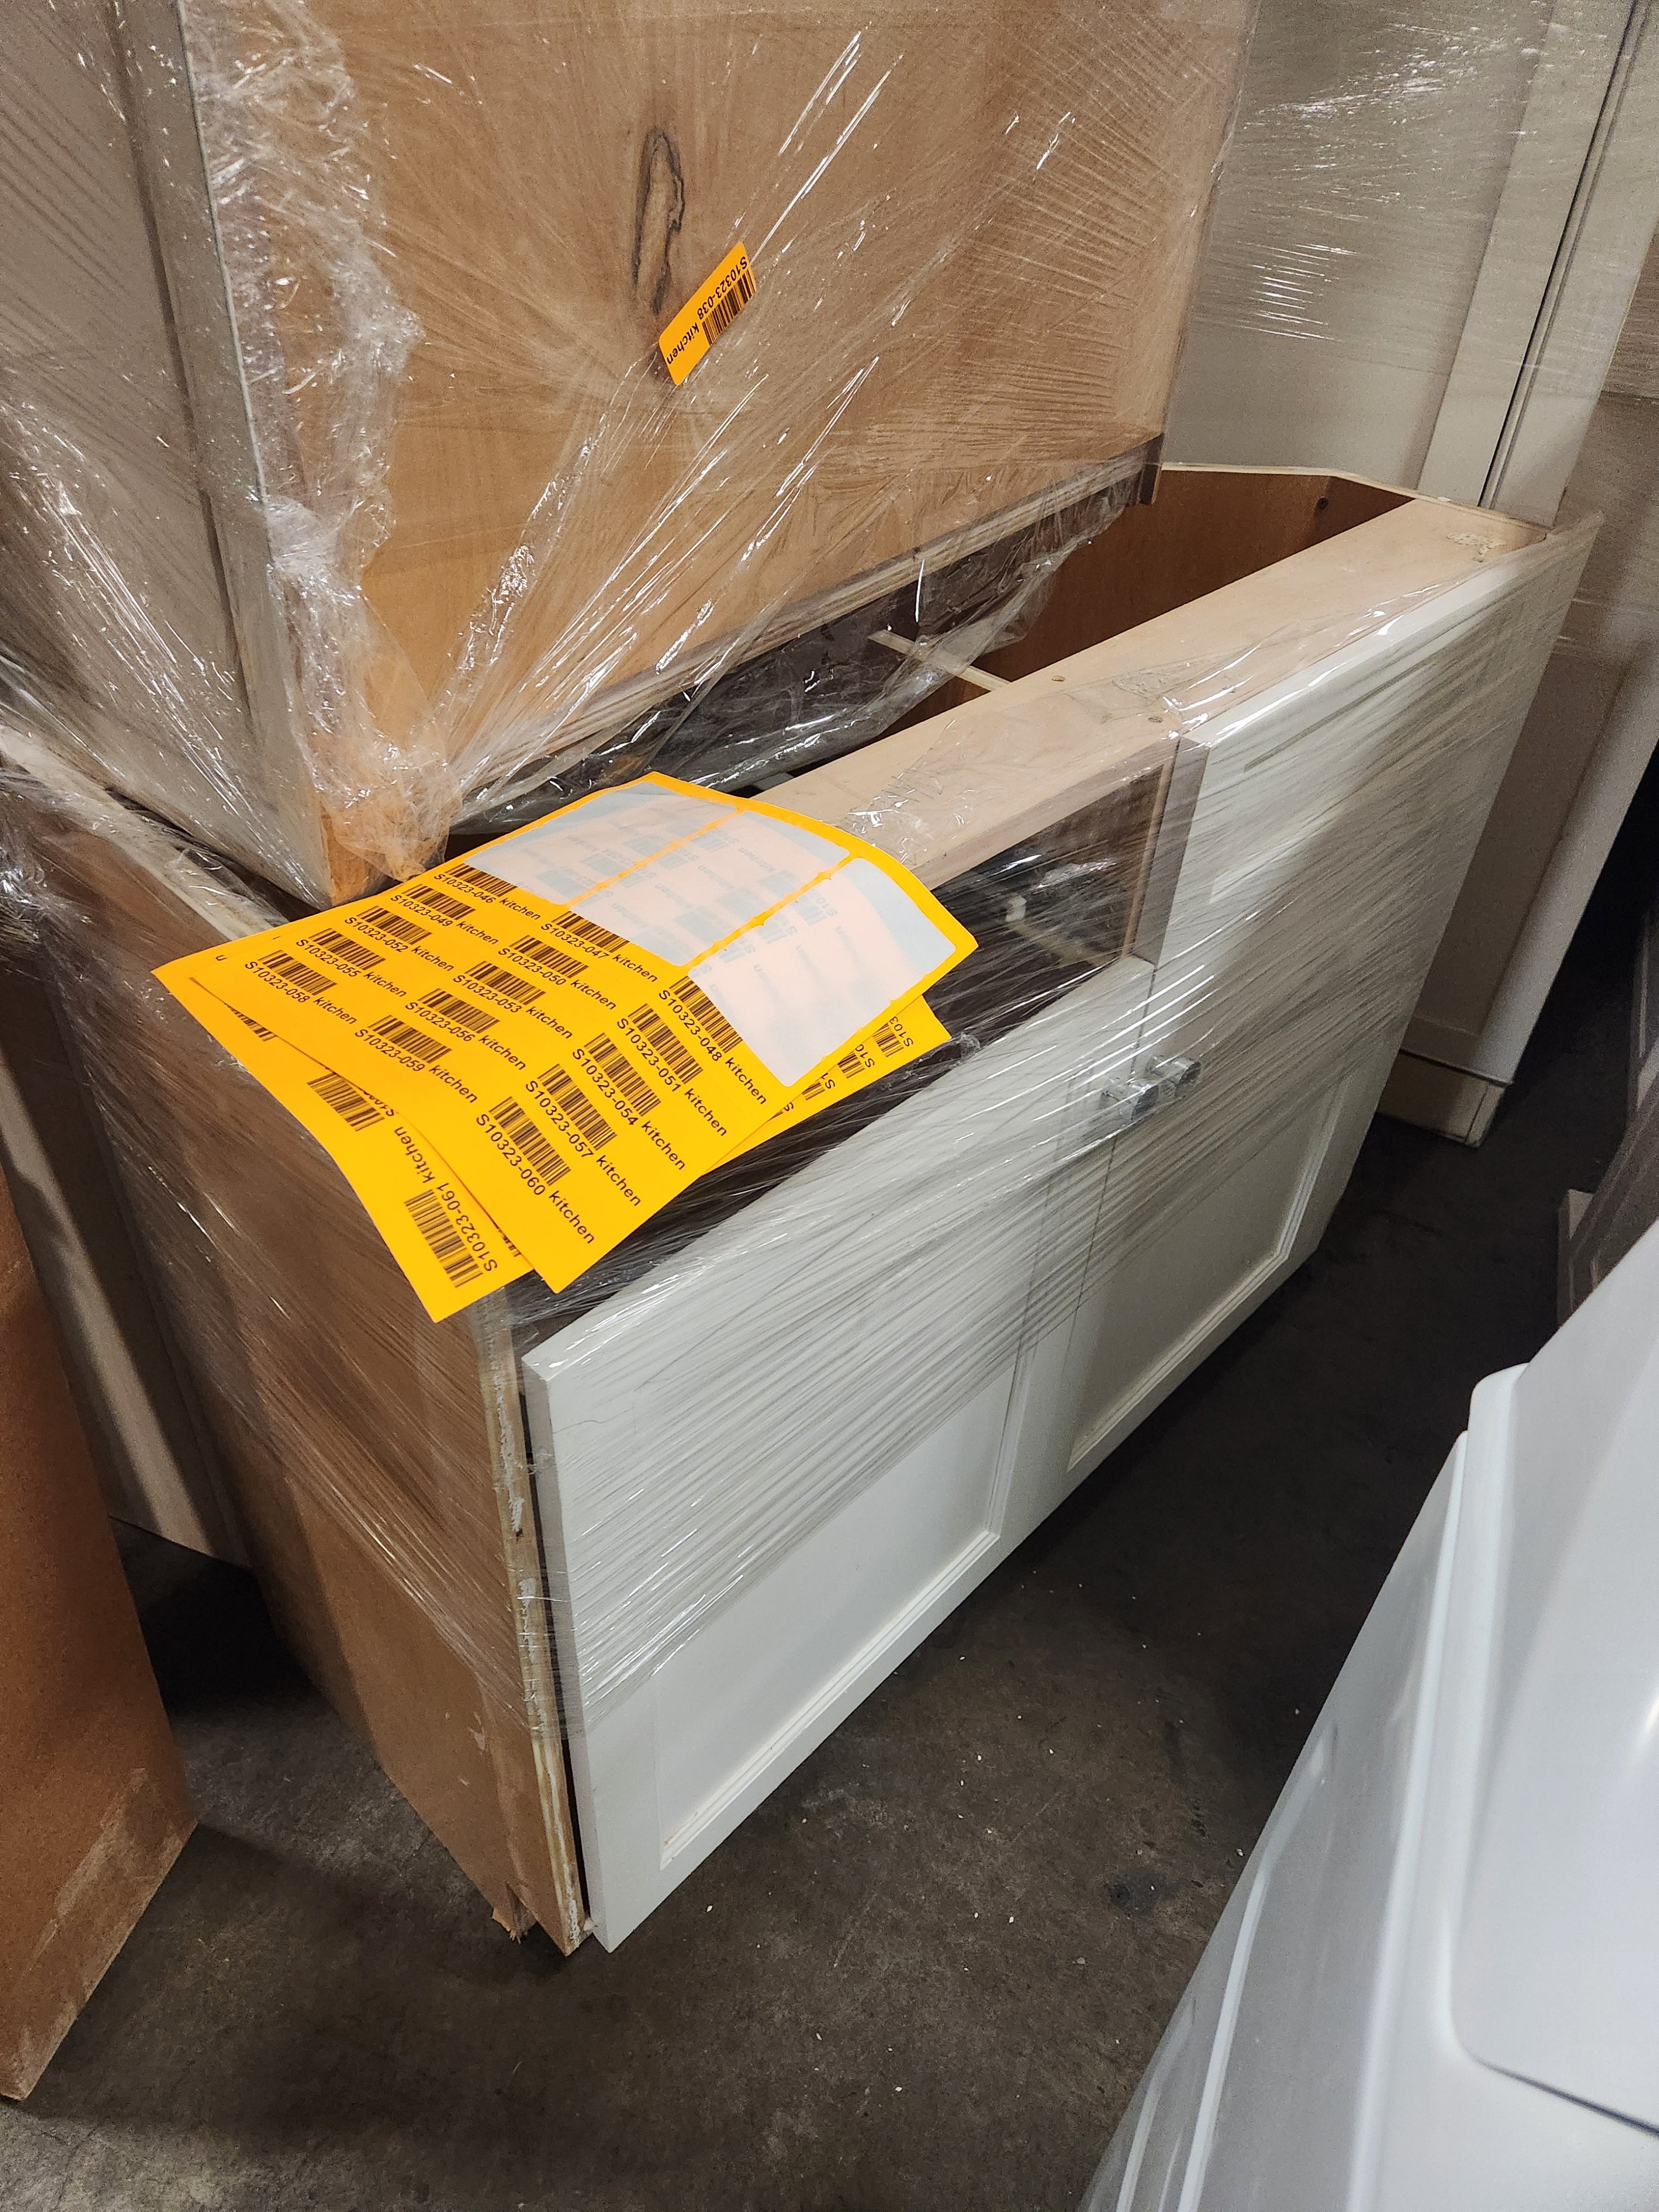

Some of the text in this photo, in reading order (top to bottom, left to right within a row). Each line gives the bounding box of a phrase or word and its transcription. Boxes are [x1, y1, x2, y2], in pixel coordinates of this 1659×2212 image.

[666, 256, 747, 364] S10323-038 kitchen
[390, 894, 499, 945] S10323-049 kitchen
[434, 873, 542, 920] S10323-046 kitchen
[296, 939, 408, 997] S10323-055 kitchen
[344, 916, 455, 971] S10323-052 kitchen
[540, 923, 658, 983] S10323-047 kitchen
[244, 961, 358, 1025] S10323-058 kitchen
[453, 974, 573, 1039] S10323-053 kitchen
[498, 947, 617, 1010] S10323-050 kitchen
[354, 1029, 478, 1104] S10323-059 kitchen
[405, 1001, 526, 1070] S10323-056 kitchen
[659, 989, 768, 1105] S10323-048 kitchen
[572, 1048, 686, 1171] S10323-054 kitchen
[617, 1018, 727, 1136] S10323-051 kitchen
[525, 1080, 641, 1206] S10323-057 kitchen
[394, 1126, 498, 1272] S10323-061 kitchen
[476, 1113, 596, 1244] S10323-060 kitchen
